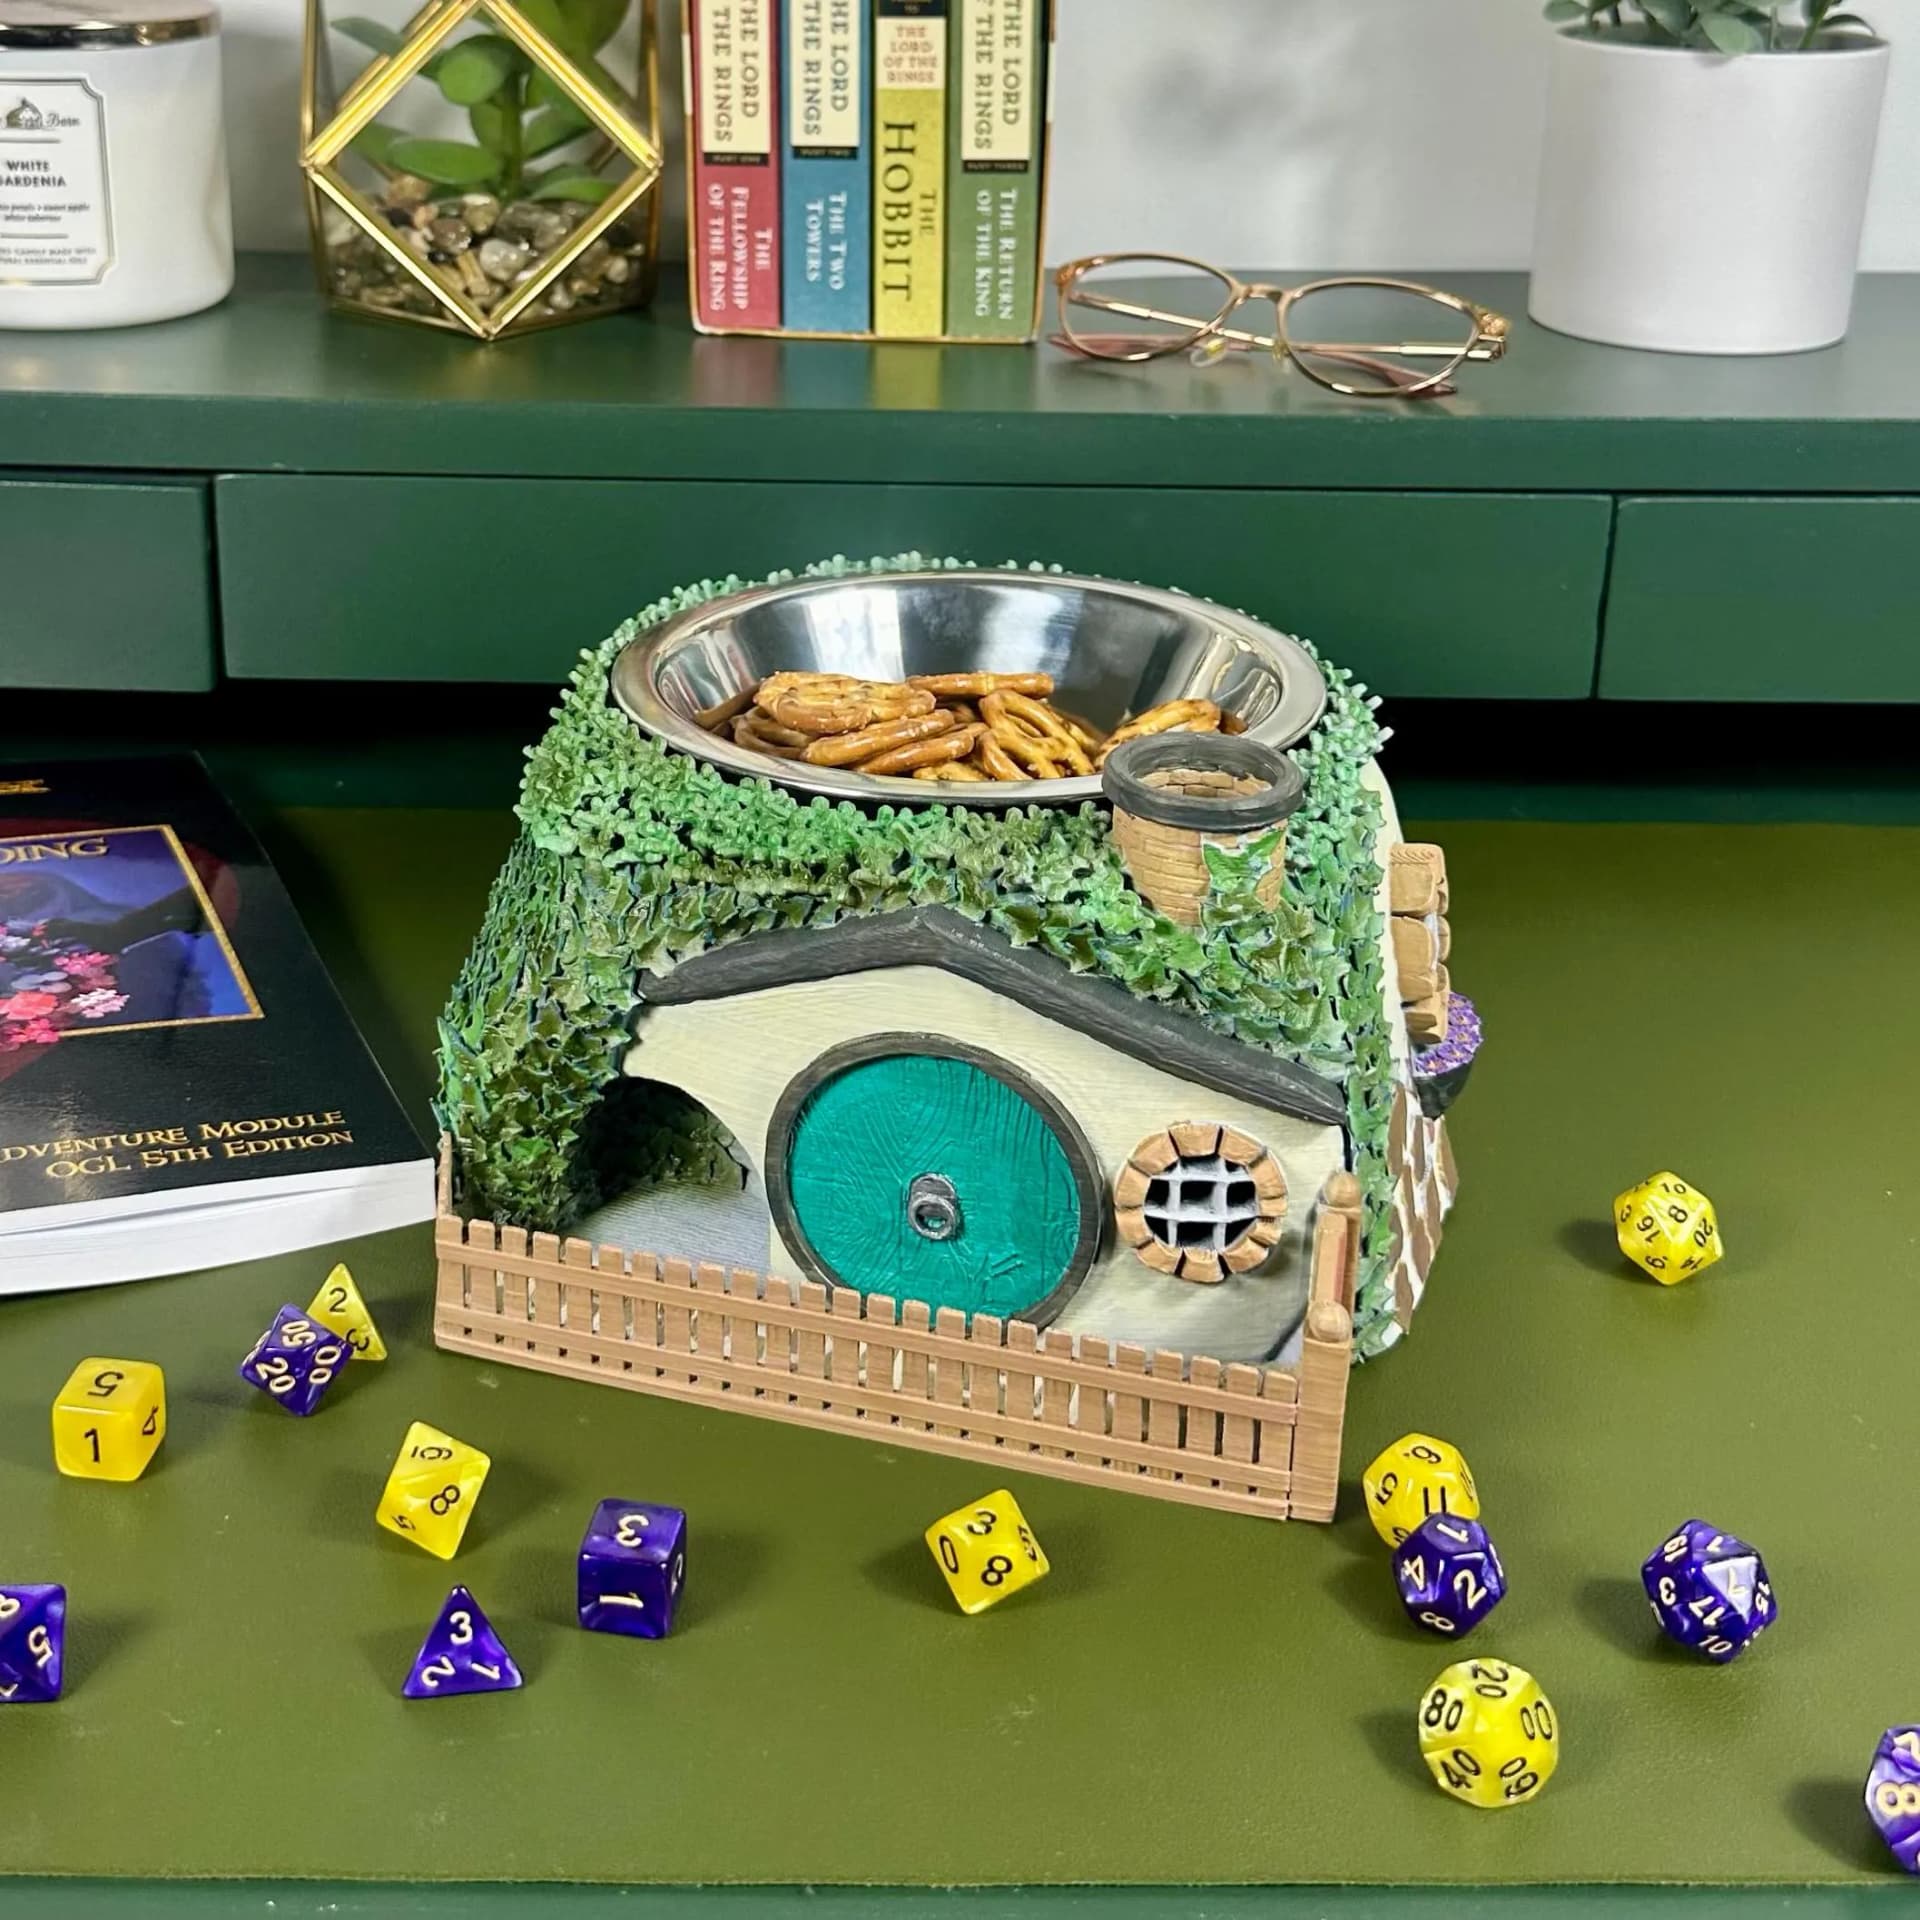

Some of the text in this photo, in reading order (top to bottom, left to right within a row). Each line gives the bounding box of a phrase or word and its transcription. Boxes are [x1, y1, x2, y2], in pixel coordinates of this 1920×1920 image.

[890, 41, 933, 53] LORD
[896, 25, 928, 38] THE
[975, 15, 995, 64] THE
[803, 0, 822, 136] THE RINGS
[830, 0, 849, 112] HE LORD
[883, 56, 938, 68] OF THE
[1002, 0, 1022, 126] THE LORD
[713, 8, 733, 142] THE RINGS
[741, 51, 760, 118] LORD
[887, 71, 935, 83] RINGS
[974, 74, 993, 149] RINGS
[6, 160, 50, 172] WHITE
[883, 120, 916, 302] HOBBIT
[920, 189, 936, 236] THE
[708, 183, 727, 311] OF THE RING
[731, 186, 749, 309] FELLOWSHIP
[754, 228, 773, 270] THE
[806, 198, 824, 282] TOWERS
[829, 191, 847, 290] THE TWO
[975, 189, 992, 317] OF THE KING
[998, 187, 1018, 320] THE RETURN
[0, 1110, 346, 1164] DVENTURE MODULE
[46, 1155, 132, 1178] OGL
[223, 1130, 354, 1158] EDITION
[1660, 1182, 1687, 1194] 10
[1668, 1205, 1688, 1224] 8
[1693, 1218, 1713, 1248] 20
[328, 1287, 349, 1313] 2
[281, 1320, 316, 1348] 50
[88, 1370, 124, 1398] 5
[256, 1357, 296, 1393] 20
[84, 1427, 101, 1464] 1
[429, 1484, 461, 1516] 8
[1374, 1471, 1399, 1505] 5
[615, 1514, 650, 1548] 3
[967, 1509, 997, 1536] 3
[938, 1535, 960, 1574] 0
[980, 1555, 1013, 1587] 8
[1403, 1554, 1425, 1592] 4
[1453, 1568, 1488, 1610] 2
[1659, 1576, 1676, 1606] 3
[599, 1591, 645, 1609] 1
[1688, 1595, 1725, 1626] 17
[449, 1611, 473, 1645] 3
[1420, 1611, 1455, 1632] 8
[1698, 1634, 1733, 1654] 10
[421, 1655, 456, 1687] 2
[1471, 1664, 1510, 1698] 20
[1424, 1688, 1463, 1732] 80
[1519, 1700, 1553, 1741] 00
[1440, 1748, 1481, 1789] 40
